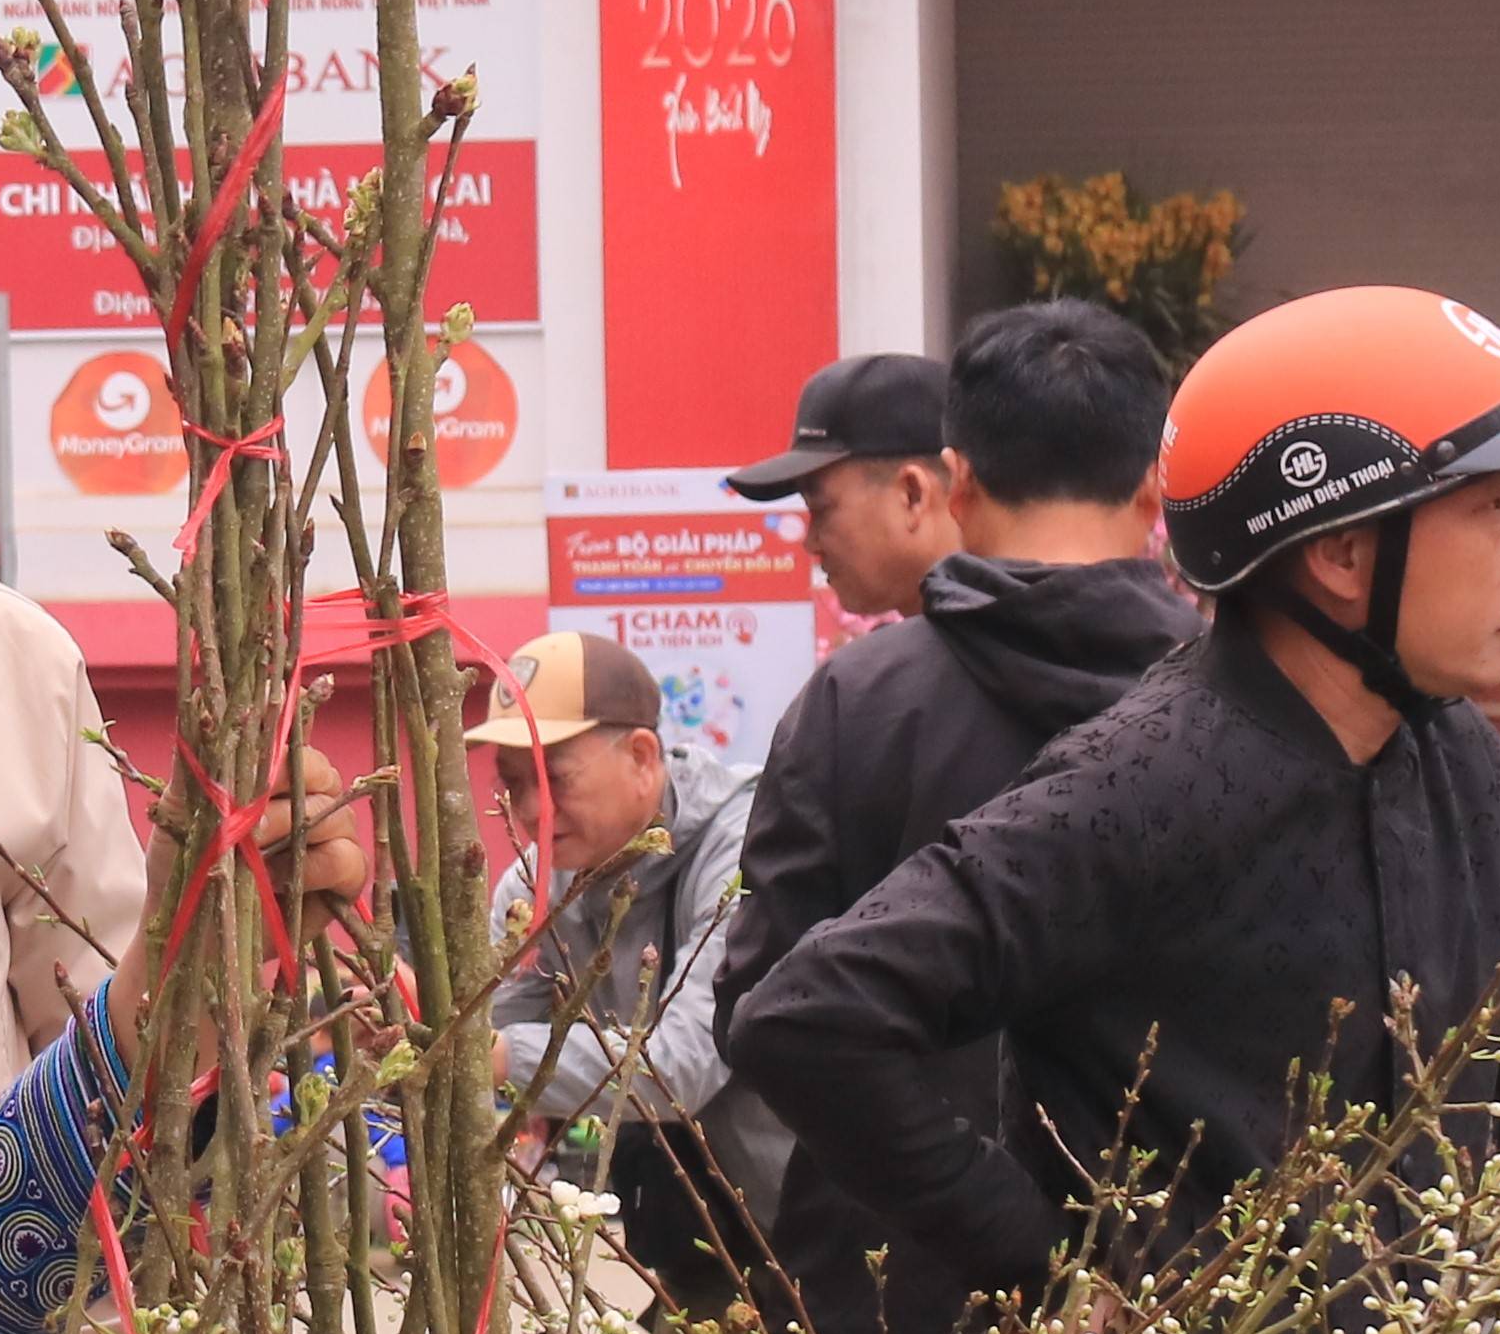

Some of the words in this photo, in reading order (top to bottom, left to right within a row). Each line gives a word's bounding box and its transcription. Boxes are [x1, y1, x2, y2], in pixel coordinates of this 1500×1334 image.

[584, 482, 681, 499] AGRIBANK
[1245, 509, 1275, 535] HUY
[1274, 491, 1315, 522] LÀNH
[1315, 477, 1351, 505] ĐIỆN
[1349, 457, 1397, 489] THOẠI
[616, 529, 650, 559] BỘ
[653, 527, 699, 555] GIẢI
[702, 529, 764, 555] PHÁP
